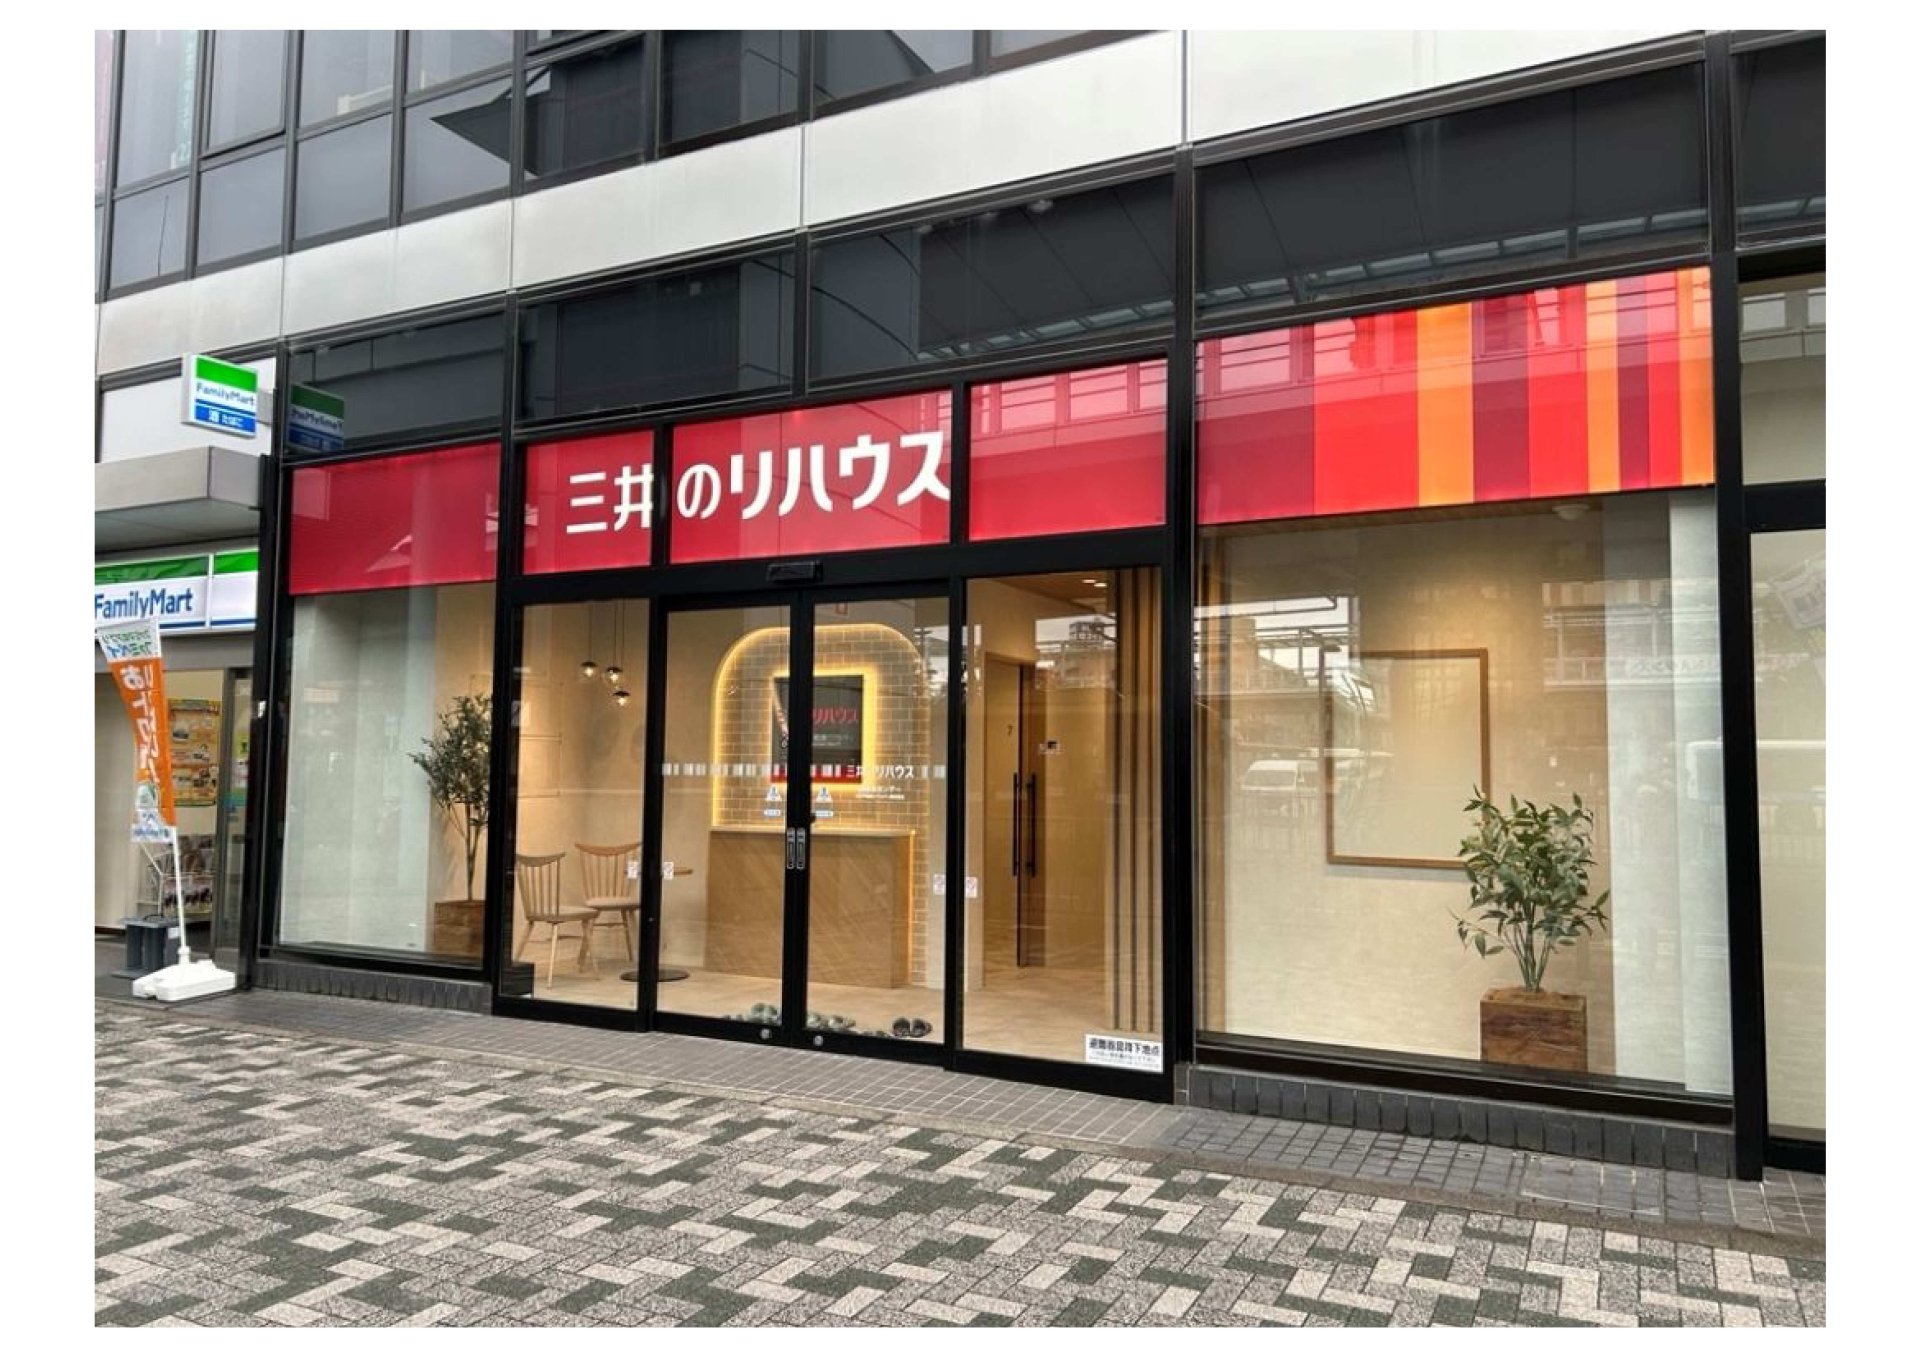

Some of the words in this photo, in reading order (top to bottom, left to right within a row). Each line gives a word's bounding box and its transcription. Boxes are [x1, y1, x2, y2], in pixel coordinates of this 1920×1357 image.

[196, 382, 255, 406] FamilyMart
[565, 430, 951, 535] 三井のリハウス
[95, 587, 193, 618] FamilyMart
